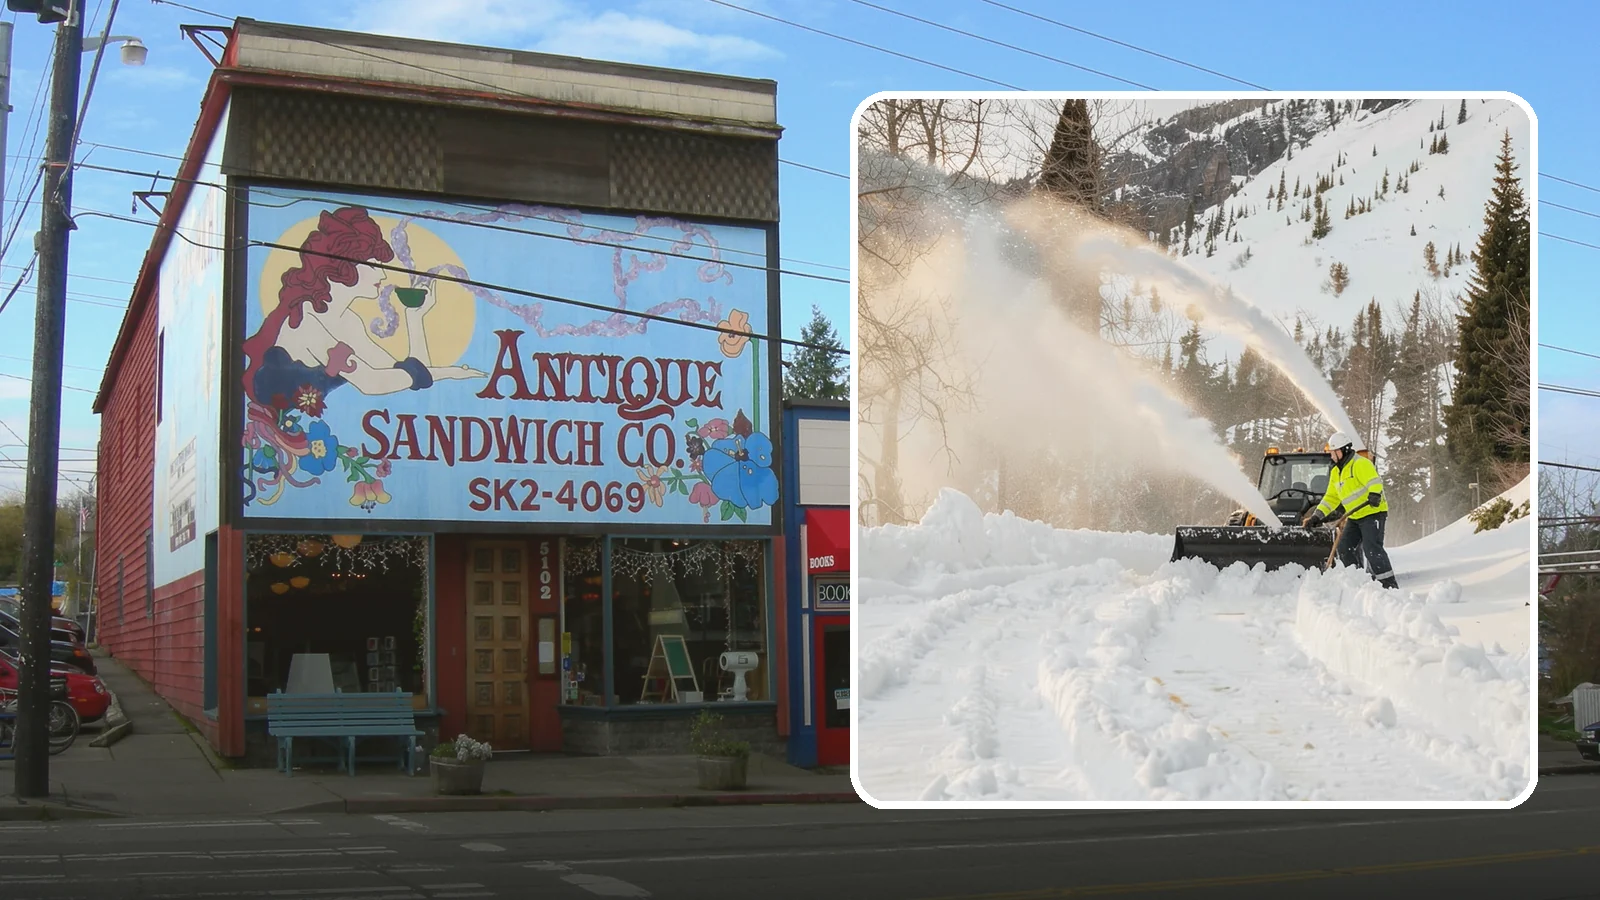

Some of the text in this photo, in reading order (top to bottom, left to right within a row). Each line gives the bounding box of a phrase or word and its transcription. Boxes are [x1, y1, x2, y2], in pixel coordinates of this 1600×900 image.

[476, 329, 724, 421] ANTIQUE
[361, 408, 685, 469] SANDWICH CO.
[468, 477, 646, 513] SK2-4069
[540, 541, 551, 600] 5102
[809, 555, 835, 569] BOOKS
